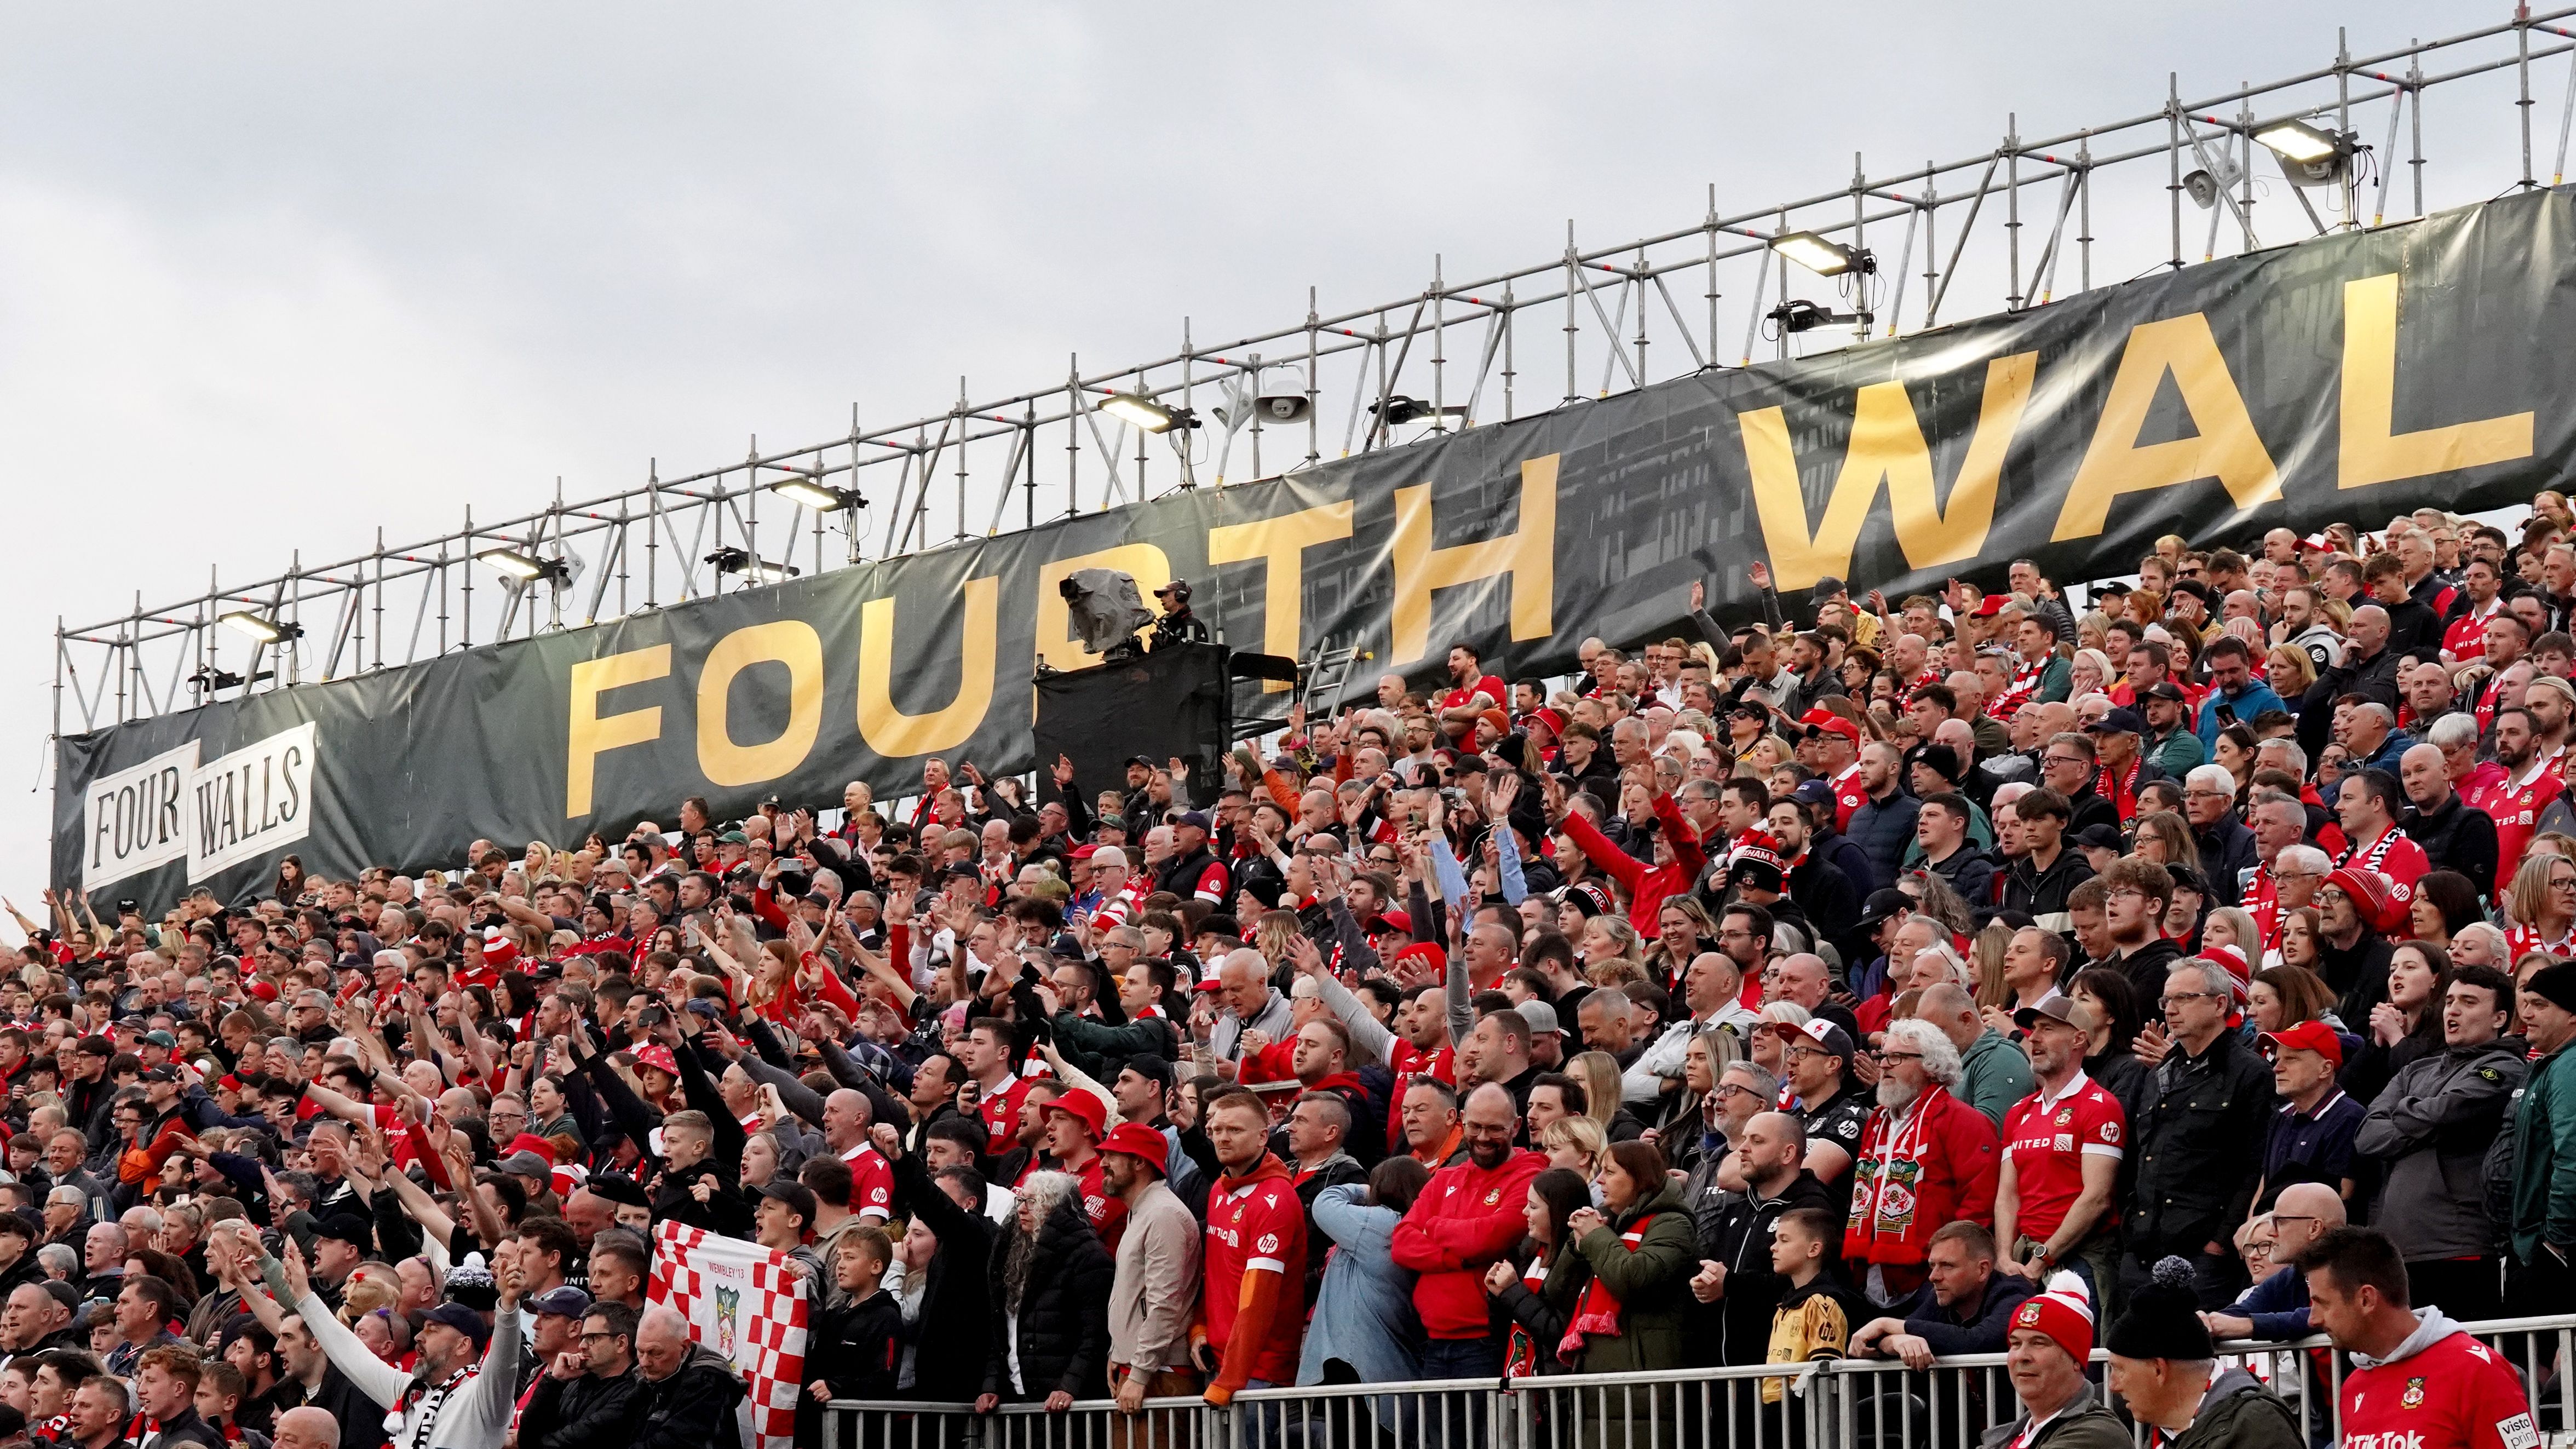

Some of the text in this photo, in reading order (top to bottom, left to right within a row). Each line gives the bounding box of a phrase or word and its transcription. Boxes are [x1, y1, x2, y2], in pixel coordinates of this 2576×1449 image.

[2312, 648, 2326, 662] hp
[92, 745, 302, 870] FOUR WALLS
[1209, 879, 1221, 892] hp
[2391, 883, 2410, 901] hp
[1838, 1120, 1859, 1138] hp
[2100, 1122, 2120, 1143] hp
[872, 1187, 887, 1203] hp
[1084, 1194, 1105, 1206] FOUR
[1084, 1204, 1107, 1218] WALLS
[1257, 1233, 1278, 1254] hp
[1819, 1321, 1836, 1342] hp
[2502, 1418, 2531, 1434] vista
[2353, 1429, 2426, 1449] TikTok
[2510, 1430, 2537, 1448] print
